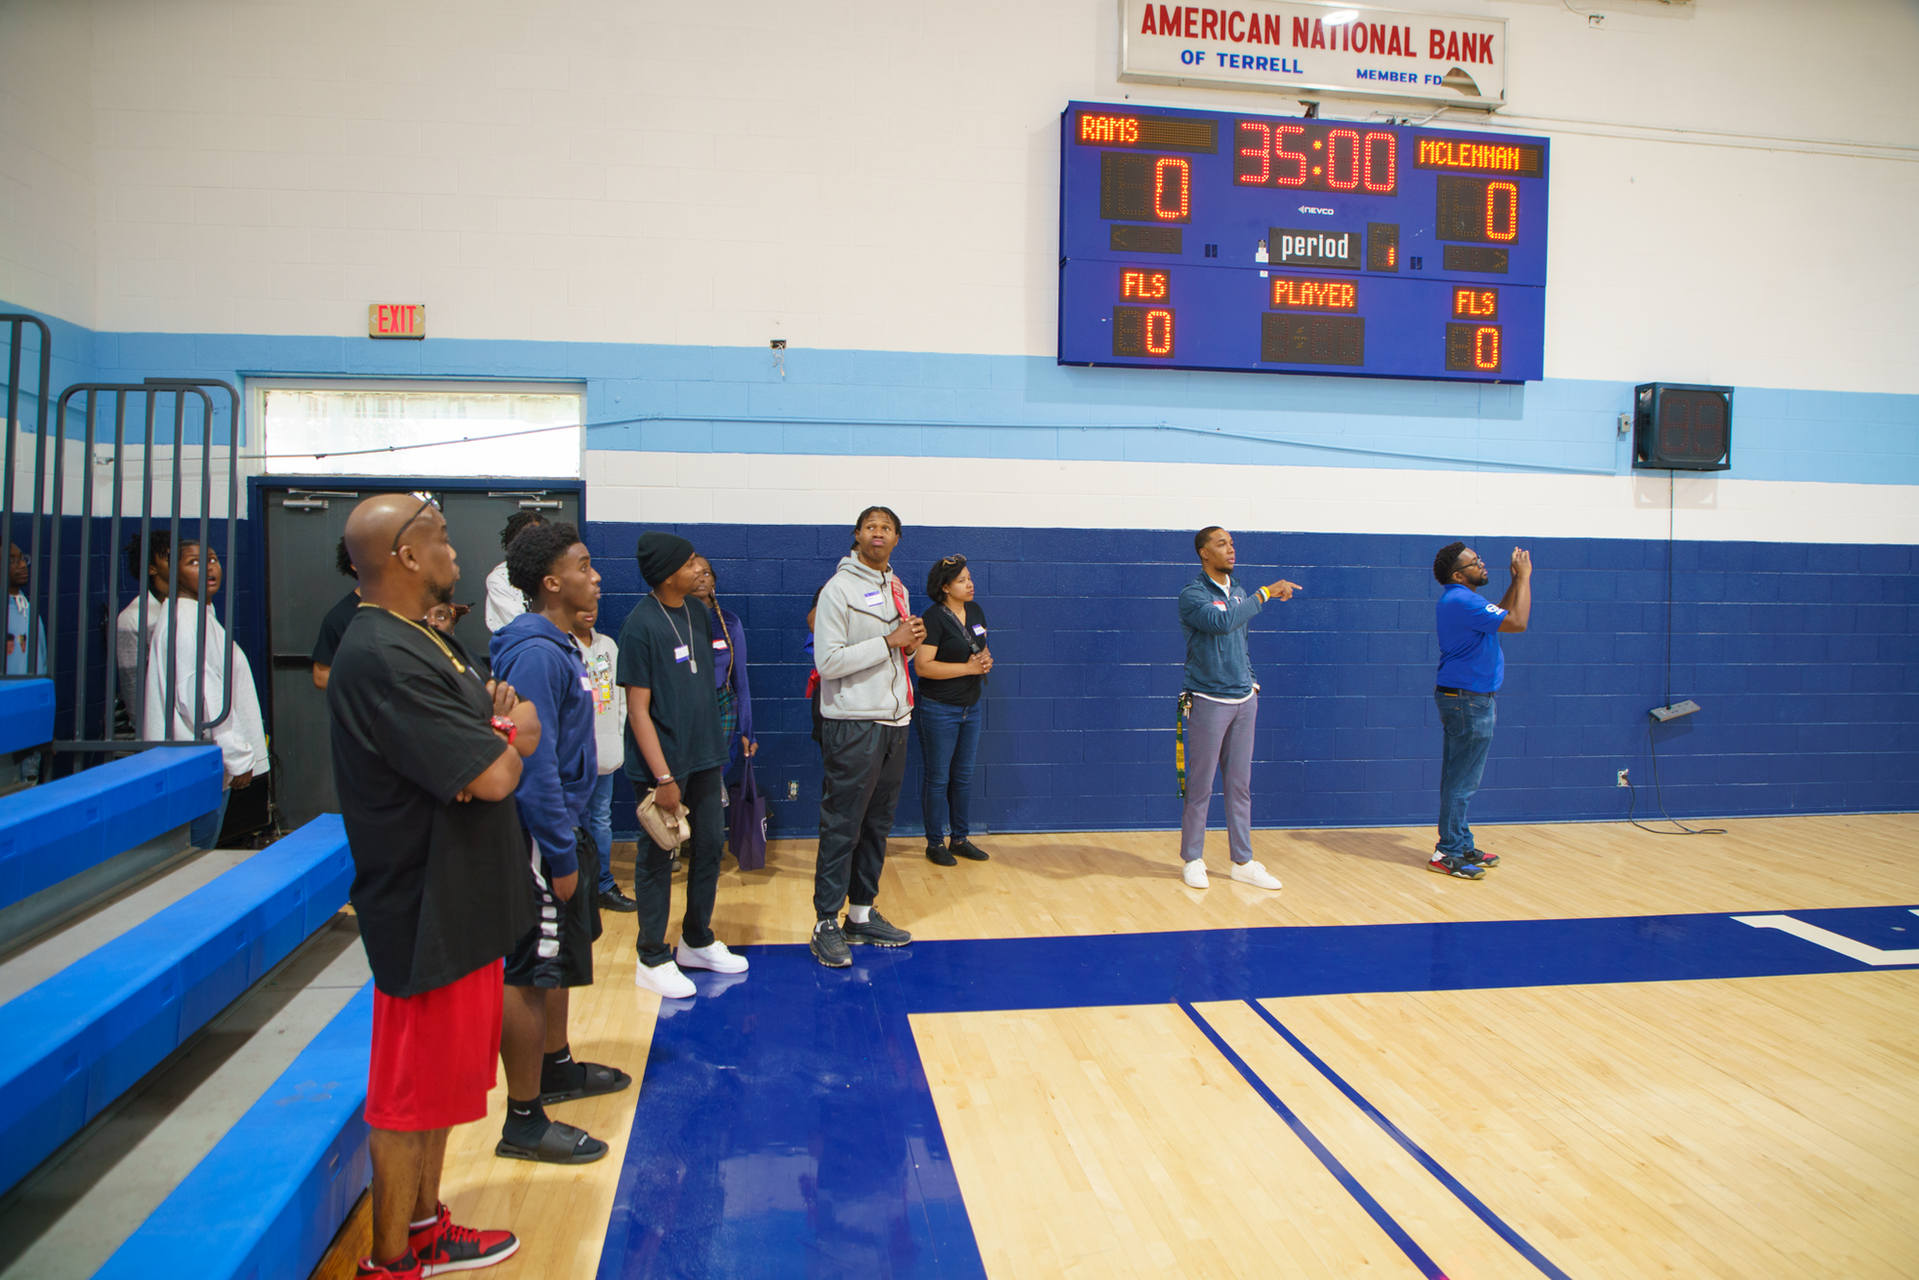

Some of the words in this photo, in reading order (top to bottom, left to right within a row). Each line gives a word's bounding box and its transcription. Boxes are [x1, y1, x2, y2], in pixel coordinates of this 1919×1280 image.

[1141, 3, 1281, 46] AMERICAN
[1292, 16, 1418, 58] NATIONAL
[1429, 29, 1495, 65] BANK
[1180, 49, 1206, 66] OF
[1216, 52, 1304, 75] TERRELL
[1356, 68, 1418, 84] MEMBER
[1424, 74, 1446, 86] FD
[1082, 115, 1139, 142] RAMS
[1240, 122, 1396, 192] 35:00
[1420, 140, 1520, 171] MCLENNAN
[1155, 158, 1189, 219] 0
[1304, 206, 1335, 216] NEVCO
[1487, 181, 1517, 240] 0
[1281, 233, 1349, 261] period
[1123, 272, 1167, 298] FLS
[1274, 280, 1355, 308] PLAYER
[1457, 291, 1495, 315] FLS
[378, 304, 417, 334] EXIT
[1146, 310, 1171, 354] 0
[1476, 327, 1499, 369] 0
